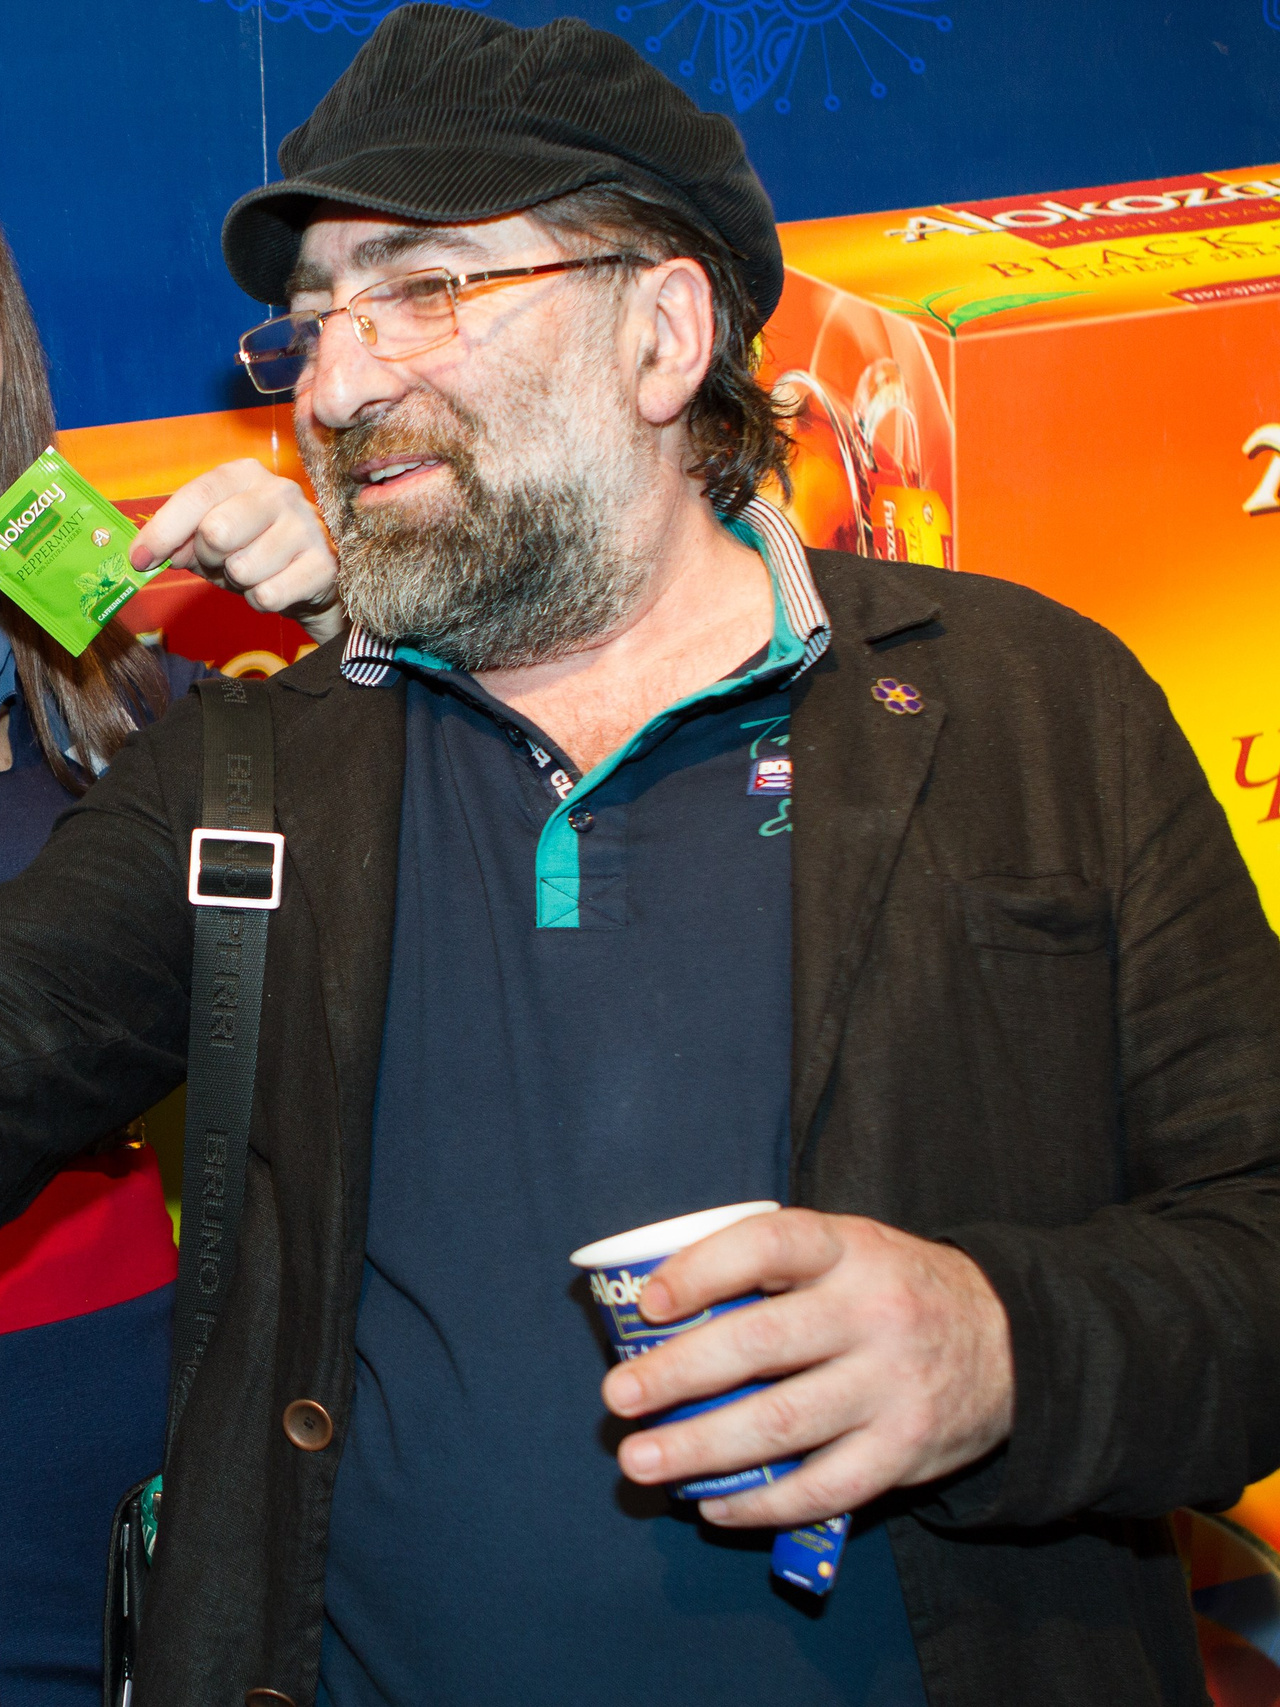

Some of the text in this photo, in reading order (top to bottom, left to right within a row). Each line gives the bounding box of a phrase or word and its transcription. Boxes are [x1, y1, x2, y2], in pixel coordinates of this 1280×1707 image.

[885, 177, 1280, 244] Alokoza
[986, 231, 1263, 279] BLACK
[16, 508, 84, 581] PEPPERMINT
[44, 541, 68, 568] NATURAL
[67, 526, 83, 546] HERBS
[97, 585, 135, 622] CAFFEINE FREE
[757, 760, 793, 776] BO
[197, 1131, 227, 1295] BRUNO
[589, 1269, 651, 1306] Alok
